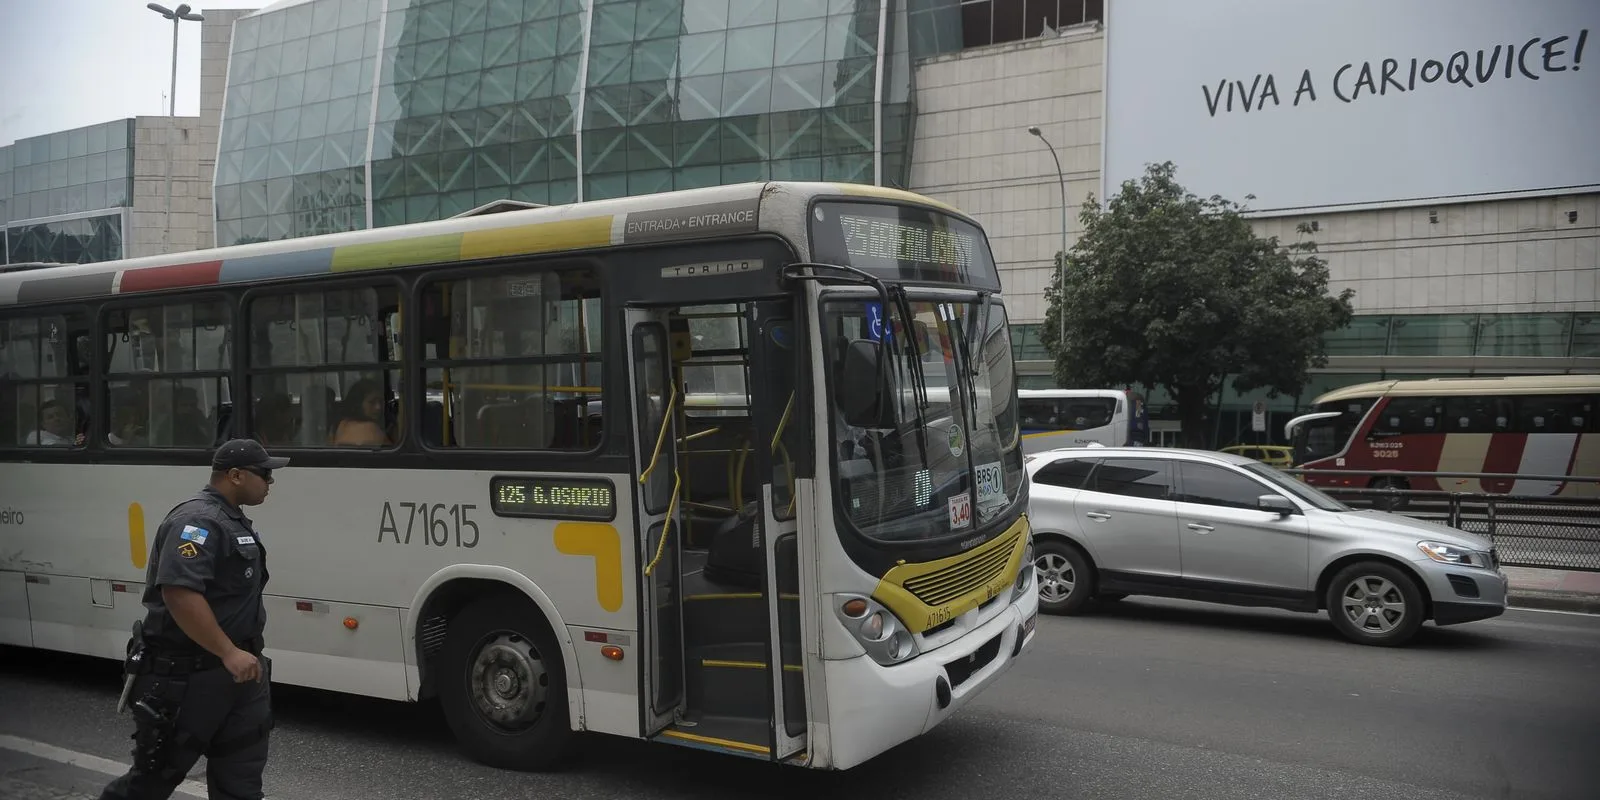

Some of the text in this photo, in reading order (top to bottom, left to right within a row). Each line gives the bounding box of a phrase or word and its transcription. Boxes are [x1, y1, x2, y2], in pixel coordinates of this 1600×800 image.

[1202, 29, 1589, 117] VIVA A CARIOQUICE!
[628, 210, 754, 234] ENTRADA ENTRANCE
[869, 221, 931, 262] GENERAL
[674, 261, 749, 276] TORINO
[1373, 450, 1399, 458] 3025
[976, 468, 991, 484] BRS
[499, 485, 610, 506] 125 G.OSORIO
[0, 506, 24, 525] eiro
[377, 501, 480, 549] A71615
[952, 502, 970, 526] 3,40
[926, 606, 951, 629] A71615
